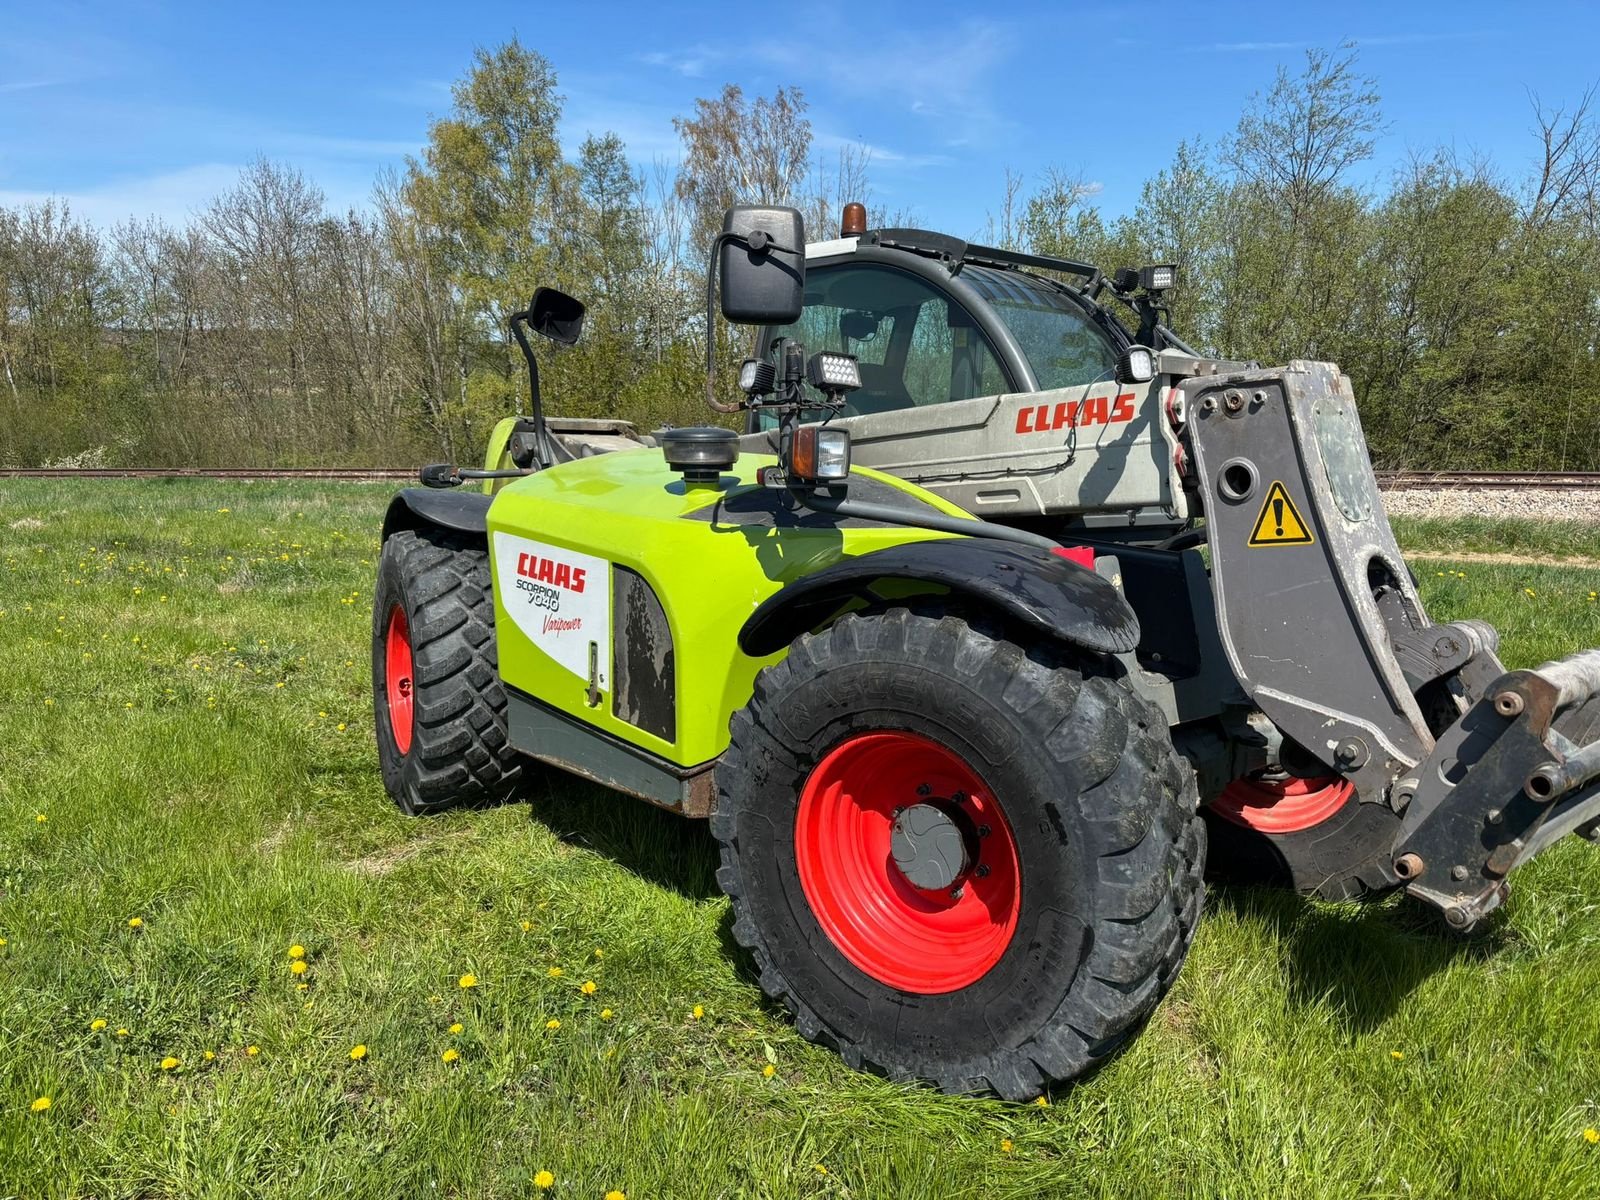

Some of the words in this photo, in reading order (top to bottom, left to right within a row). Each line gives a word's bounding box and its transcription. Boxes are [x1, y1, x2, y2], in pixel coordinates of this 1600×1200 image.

[1015, 393, 1135, 434] CLAAS
[517, 552, 586, 593] CLAAS
[516, 579, 560, 600] SCORPION
[528, 592, 560, 612] 7040
[542, 613, 582, 638] Varipower
